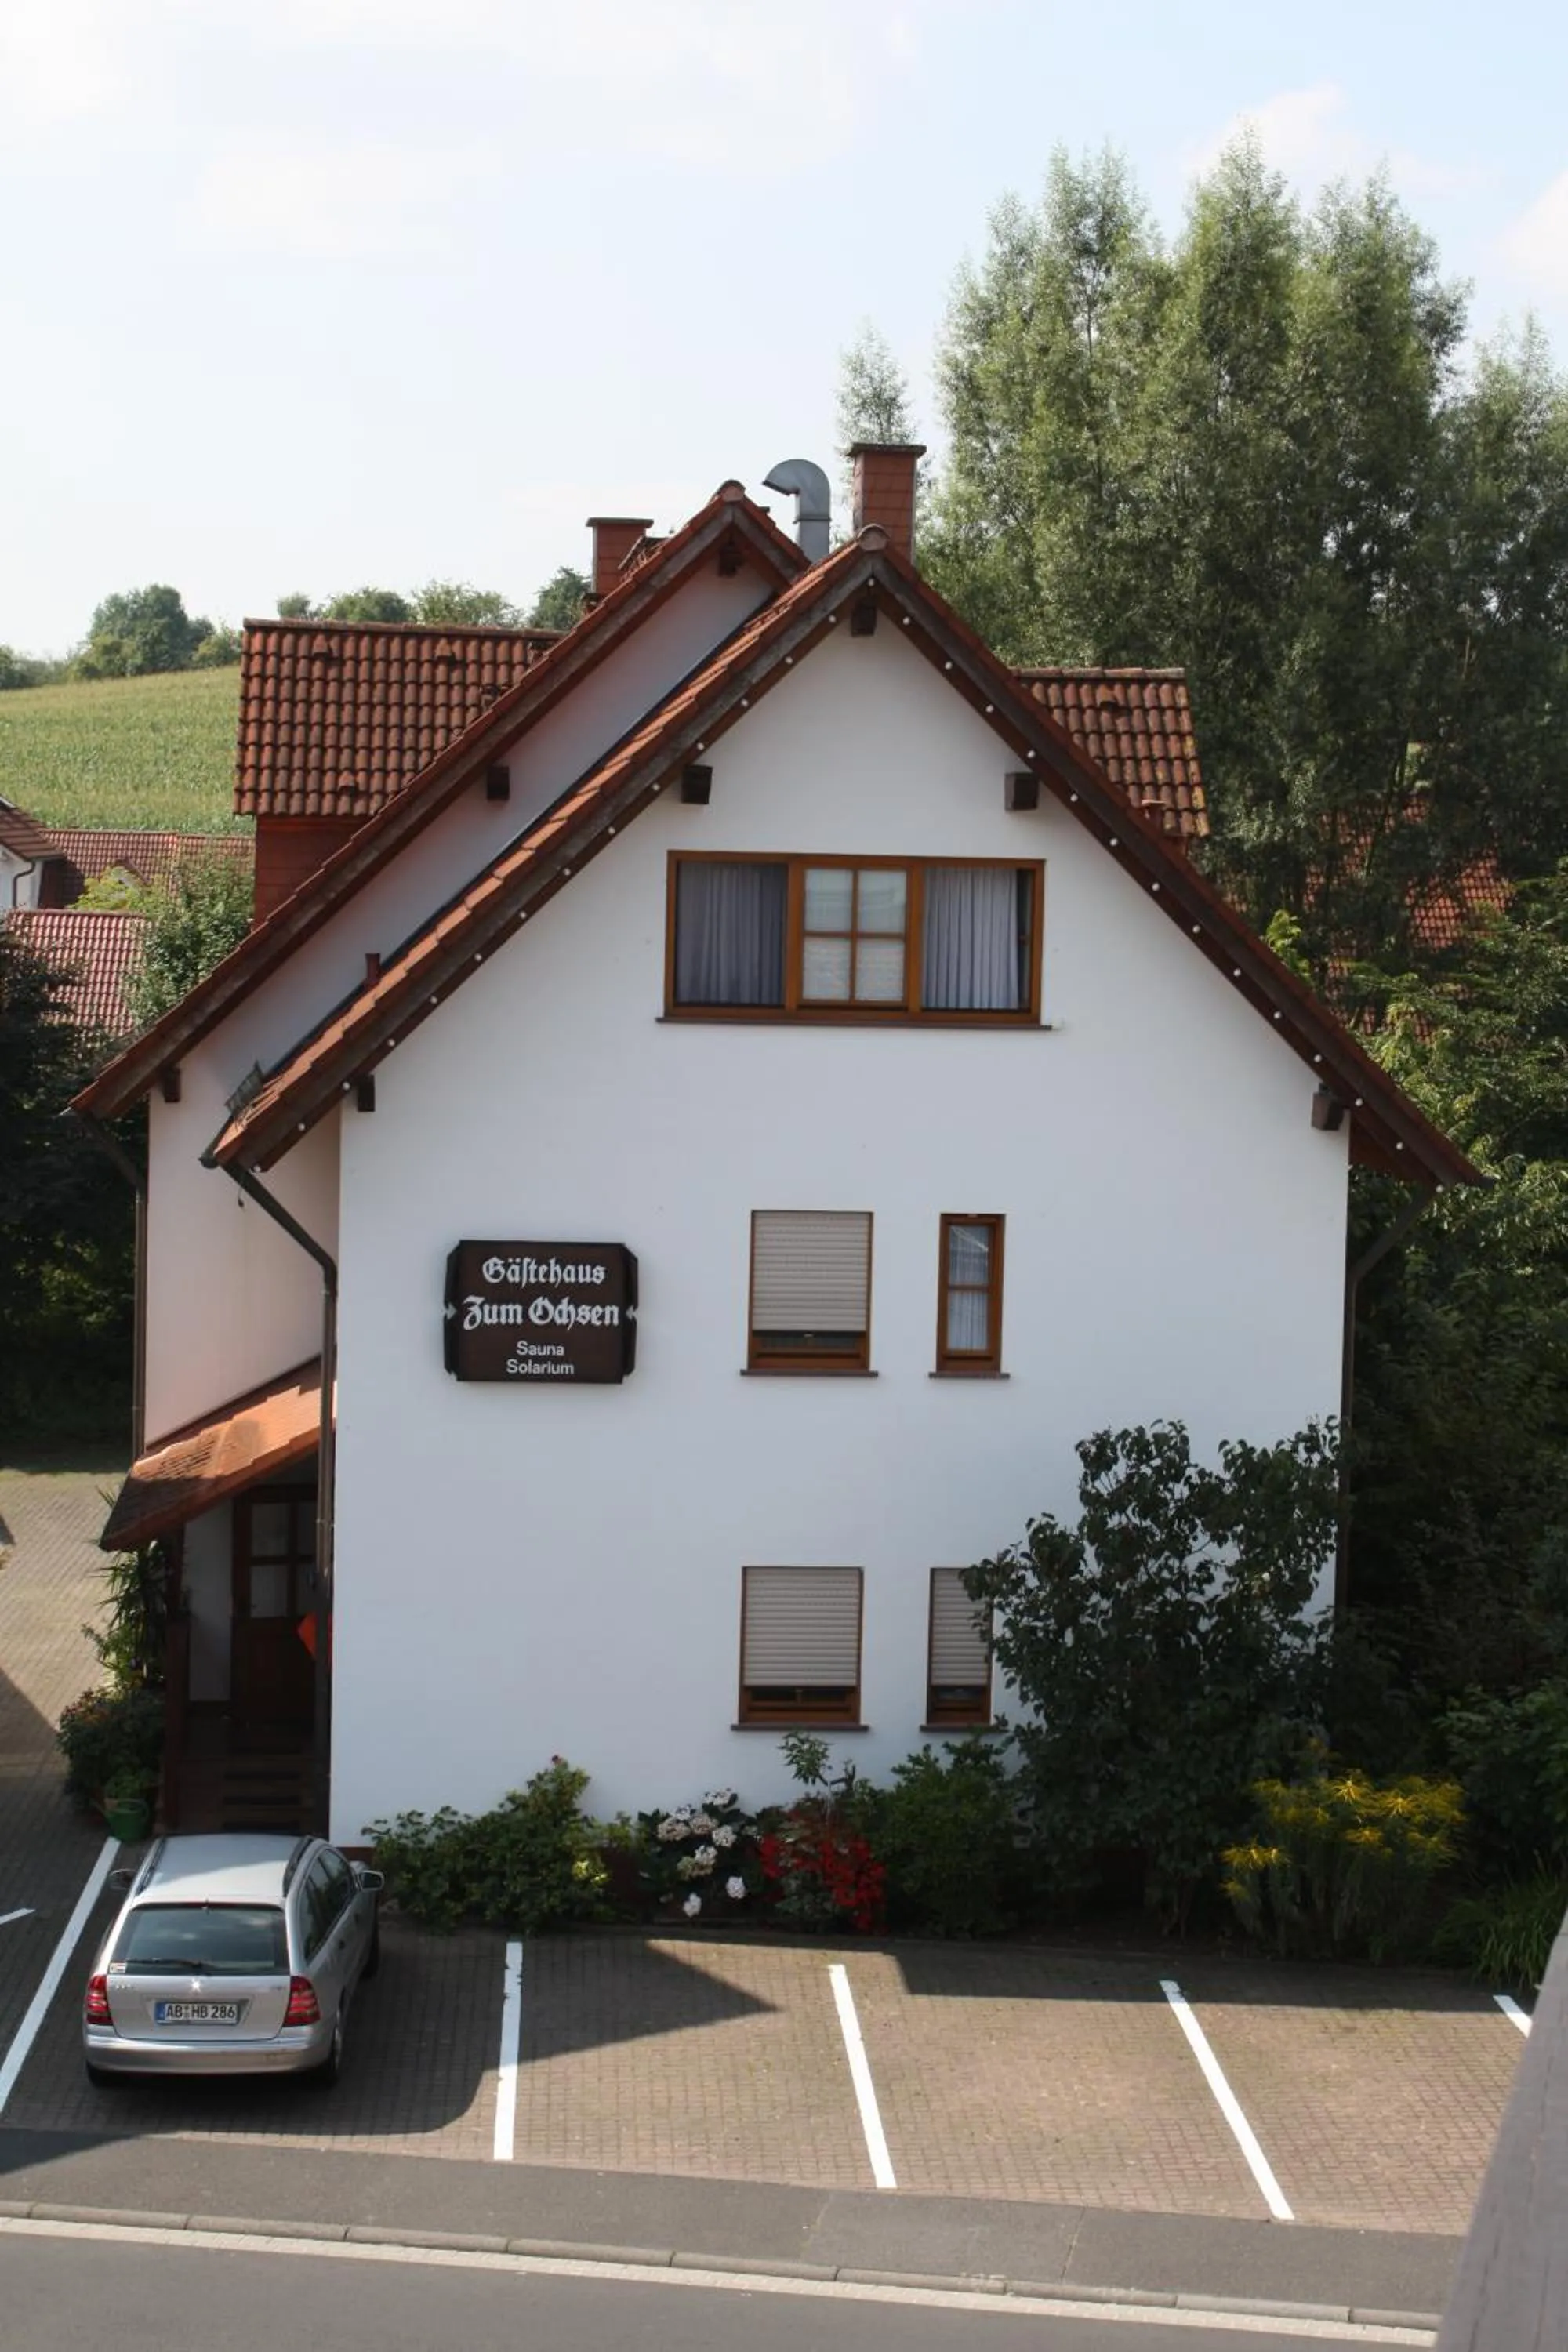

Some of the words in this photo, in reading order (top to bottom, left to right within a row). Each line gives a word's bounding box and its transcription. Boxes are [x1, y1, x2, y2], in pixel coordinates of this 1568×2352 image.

[463, 1295, 523, 1330] Zum
[528, 1295, 619, 1330] Ochsen
[516, 1340, 565, 1356] Sauna
[506, 1359, 575, 1374] Solarium
[166, 2005, 183, 2019] AB
[211, 2005, 235, 2020] 286
